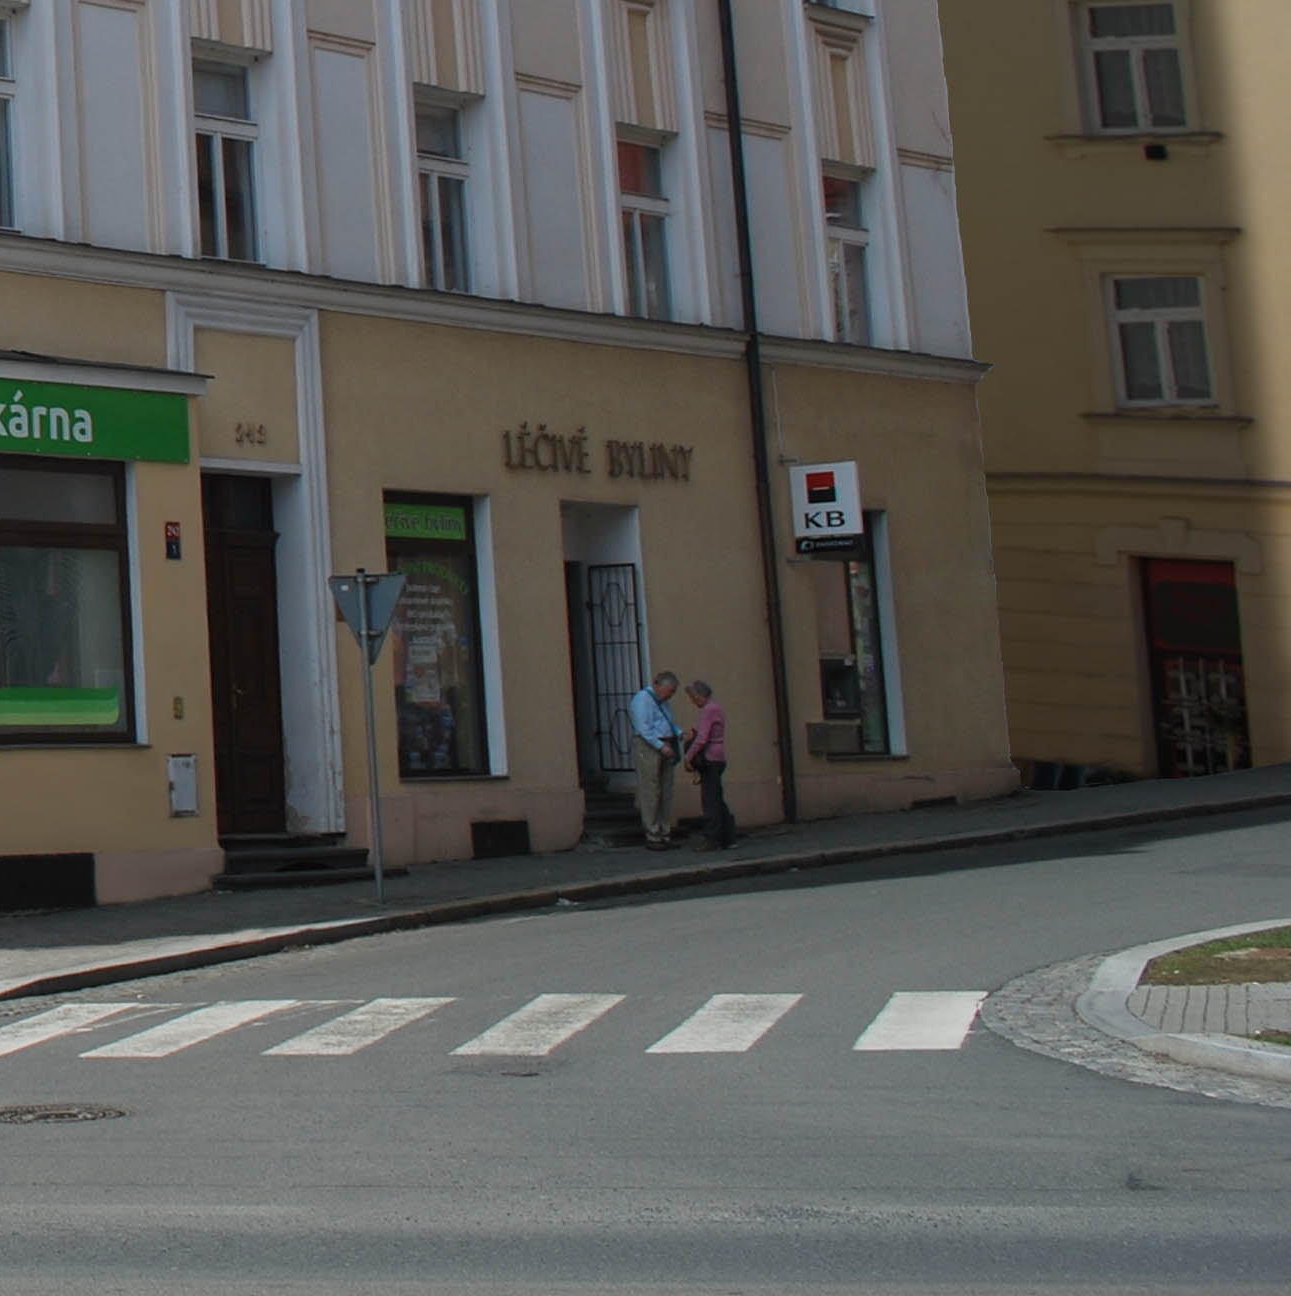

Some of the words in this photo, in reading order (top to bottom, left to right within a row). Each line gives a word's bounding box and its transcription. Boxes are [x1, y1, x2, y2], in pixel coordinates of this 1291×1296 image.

[503, 421, 591, 474] LÉČIVÉ
[605, 440, 694, 482] BYLINY
[804, 511, 845, 529] KB
